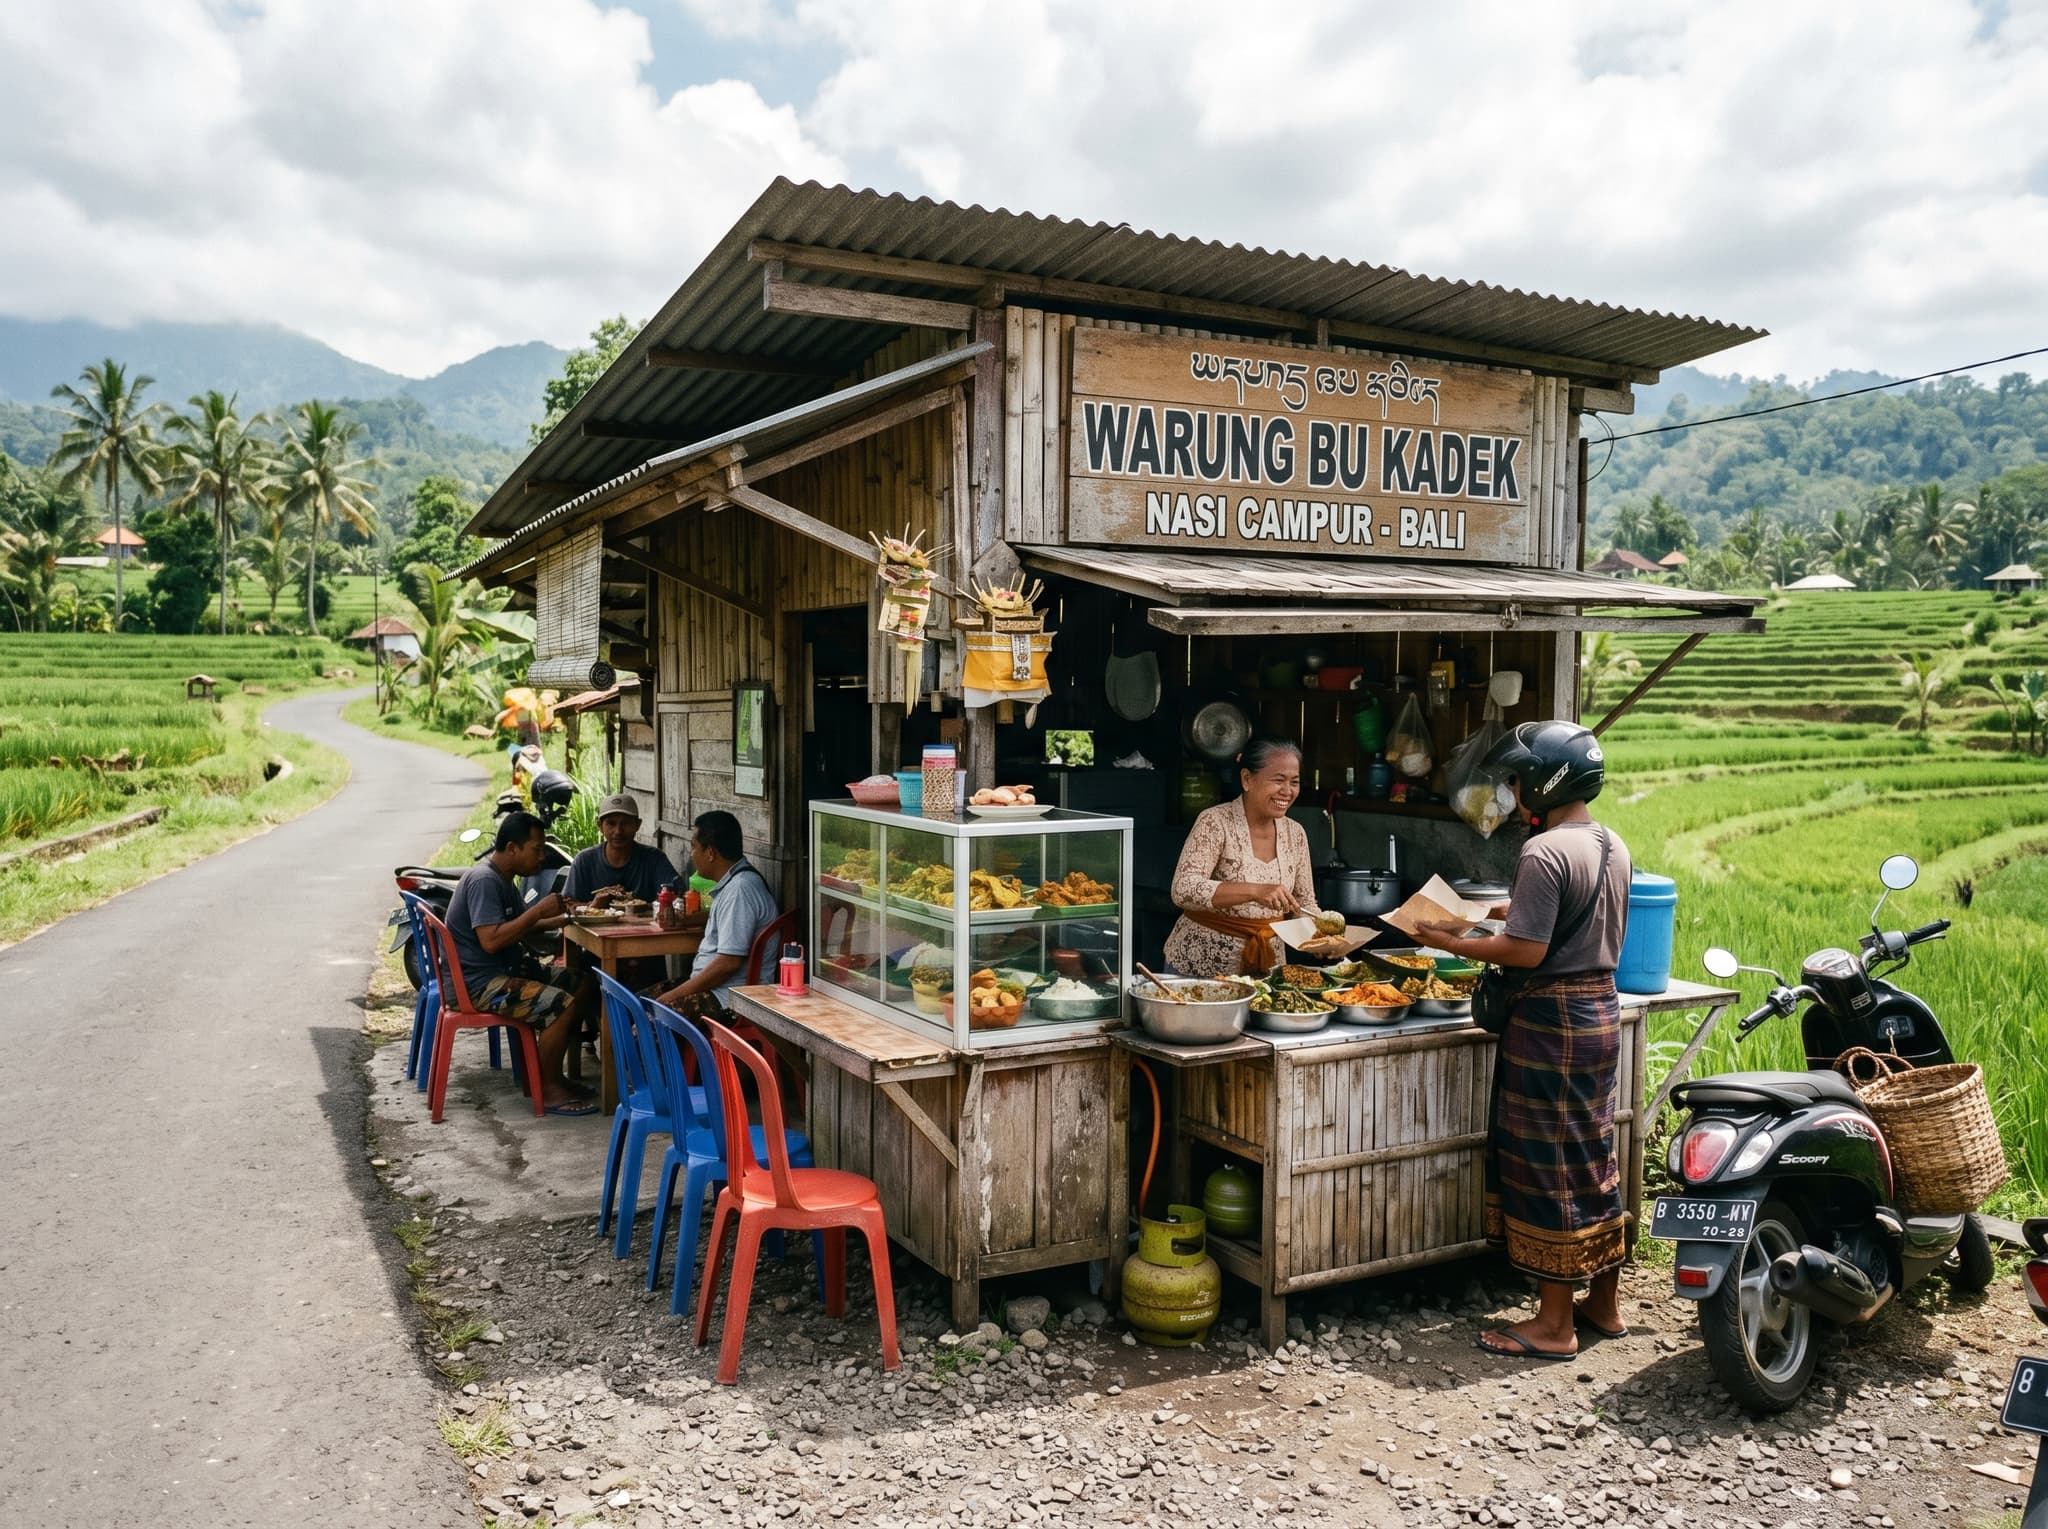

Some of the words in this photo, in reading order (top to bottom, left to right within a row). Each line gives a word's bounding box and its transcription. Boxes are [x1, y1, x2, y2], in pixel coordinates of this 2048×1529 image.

[1082, 400, 1295, 486] WARUNG
[1307, 419, 1369, 491] BU
[1380, 426, 1523, 502] KADEK
[1146, 491, 1227, 538] NASI
[1236, 497, 1374, 545] CAMPUR
[1399, 507, 1466, 551] BALI
[1656, 1202, 1668, 1219] B
[1676, 1203, 1717, 1221] 3550
